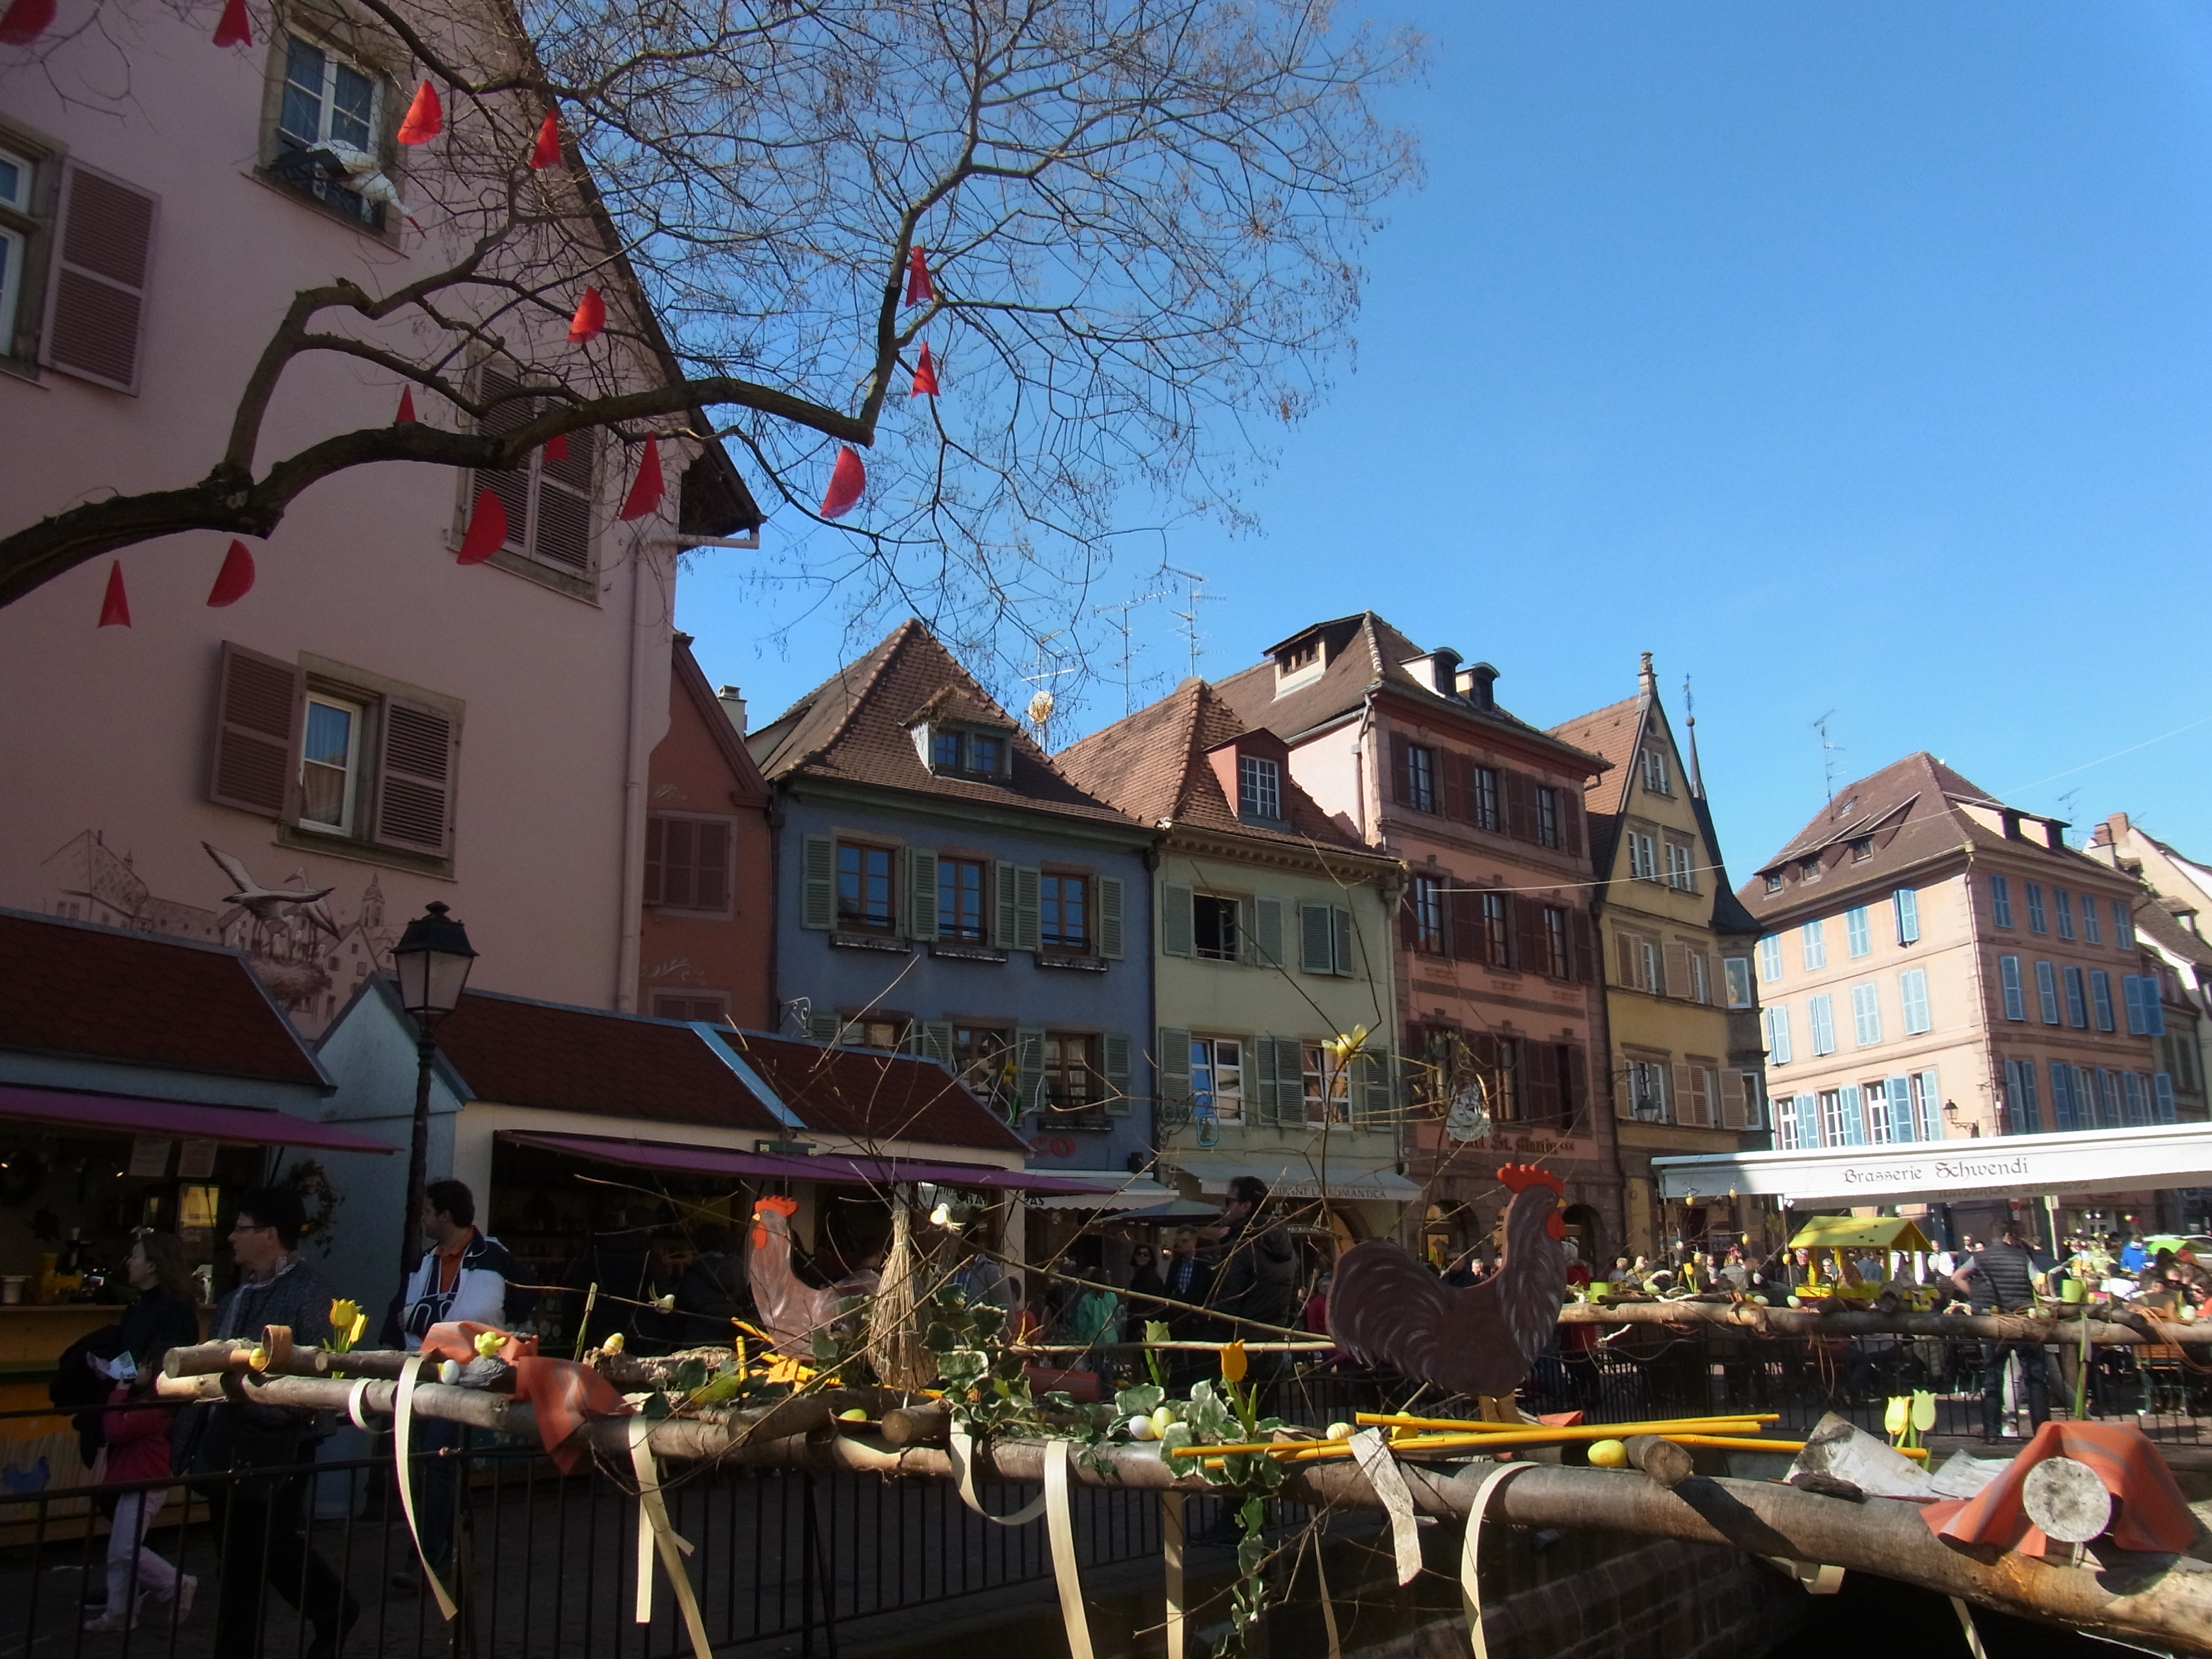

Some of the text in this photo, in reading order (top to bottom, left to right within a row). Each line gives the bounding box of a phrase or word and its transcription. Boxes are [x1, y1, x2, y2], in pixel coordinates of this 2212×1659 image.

[1842, 1158, 2029, 1183] Brasserie Schwendi
[1327, 1188, 1387, 1199] ROMANTICA
